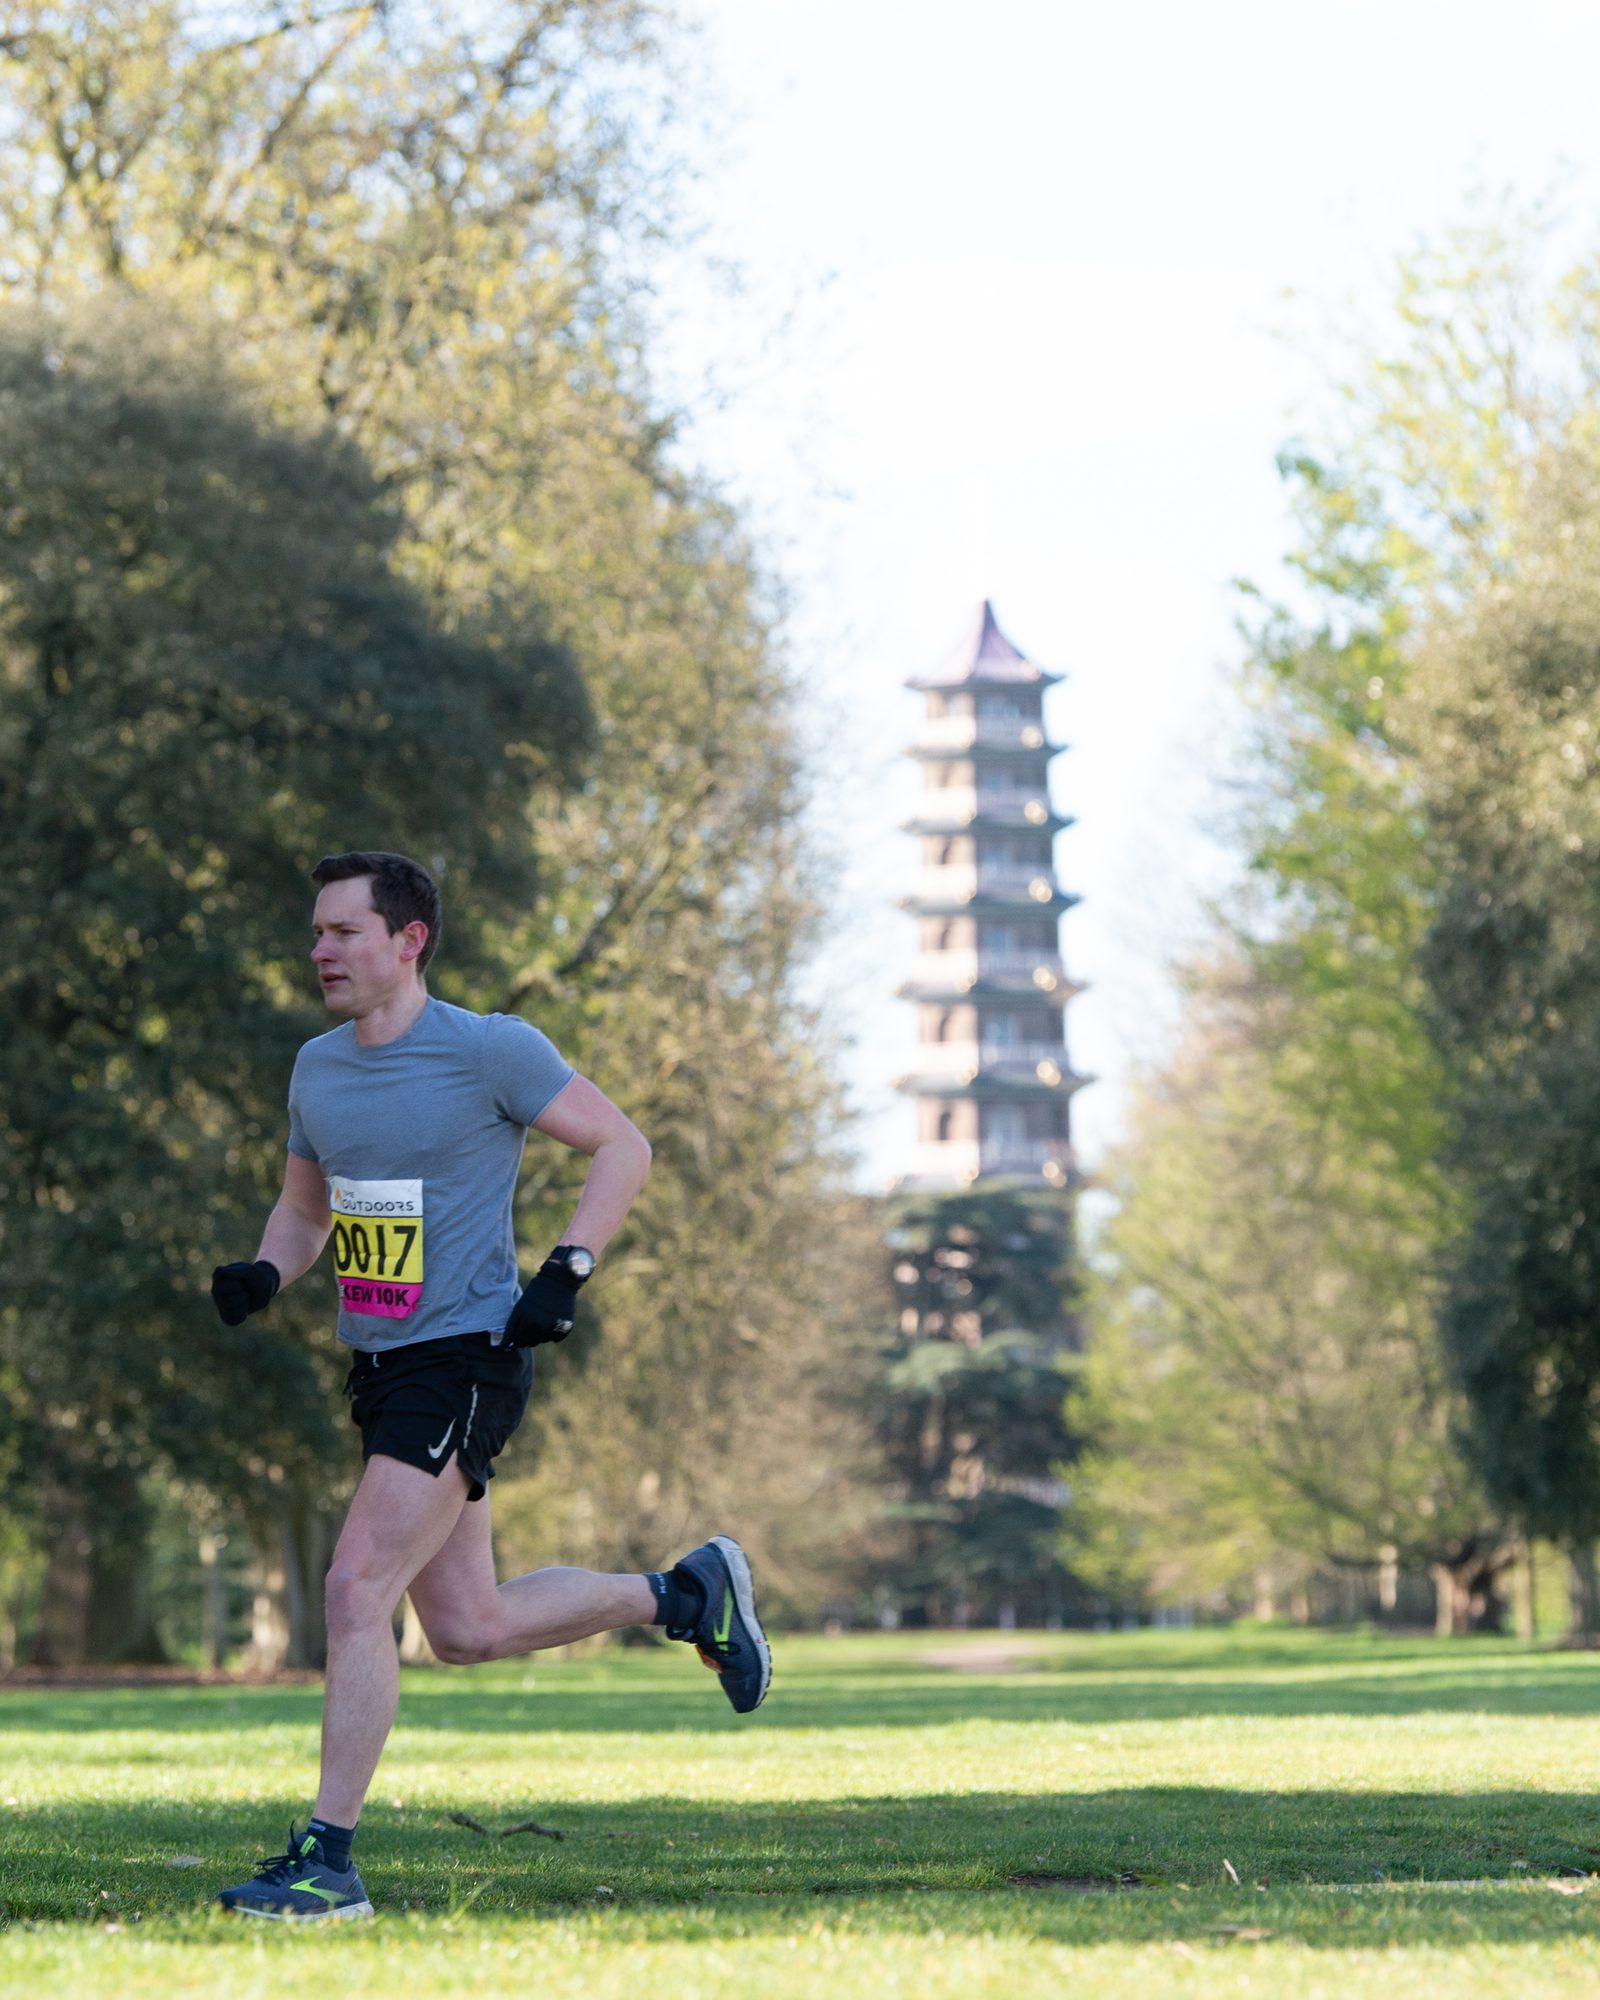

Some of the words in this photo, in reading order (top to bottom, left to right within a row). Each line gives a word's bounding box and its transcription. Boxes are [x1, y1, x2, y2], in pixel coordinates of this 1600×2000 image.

[342, 1199, 414, 1211] OUTDOORS
[334, 1220, 417, 1276] 0017
[376, 1287, 409, 1306] 10K
